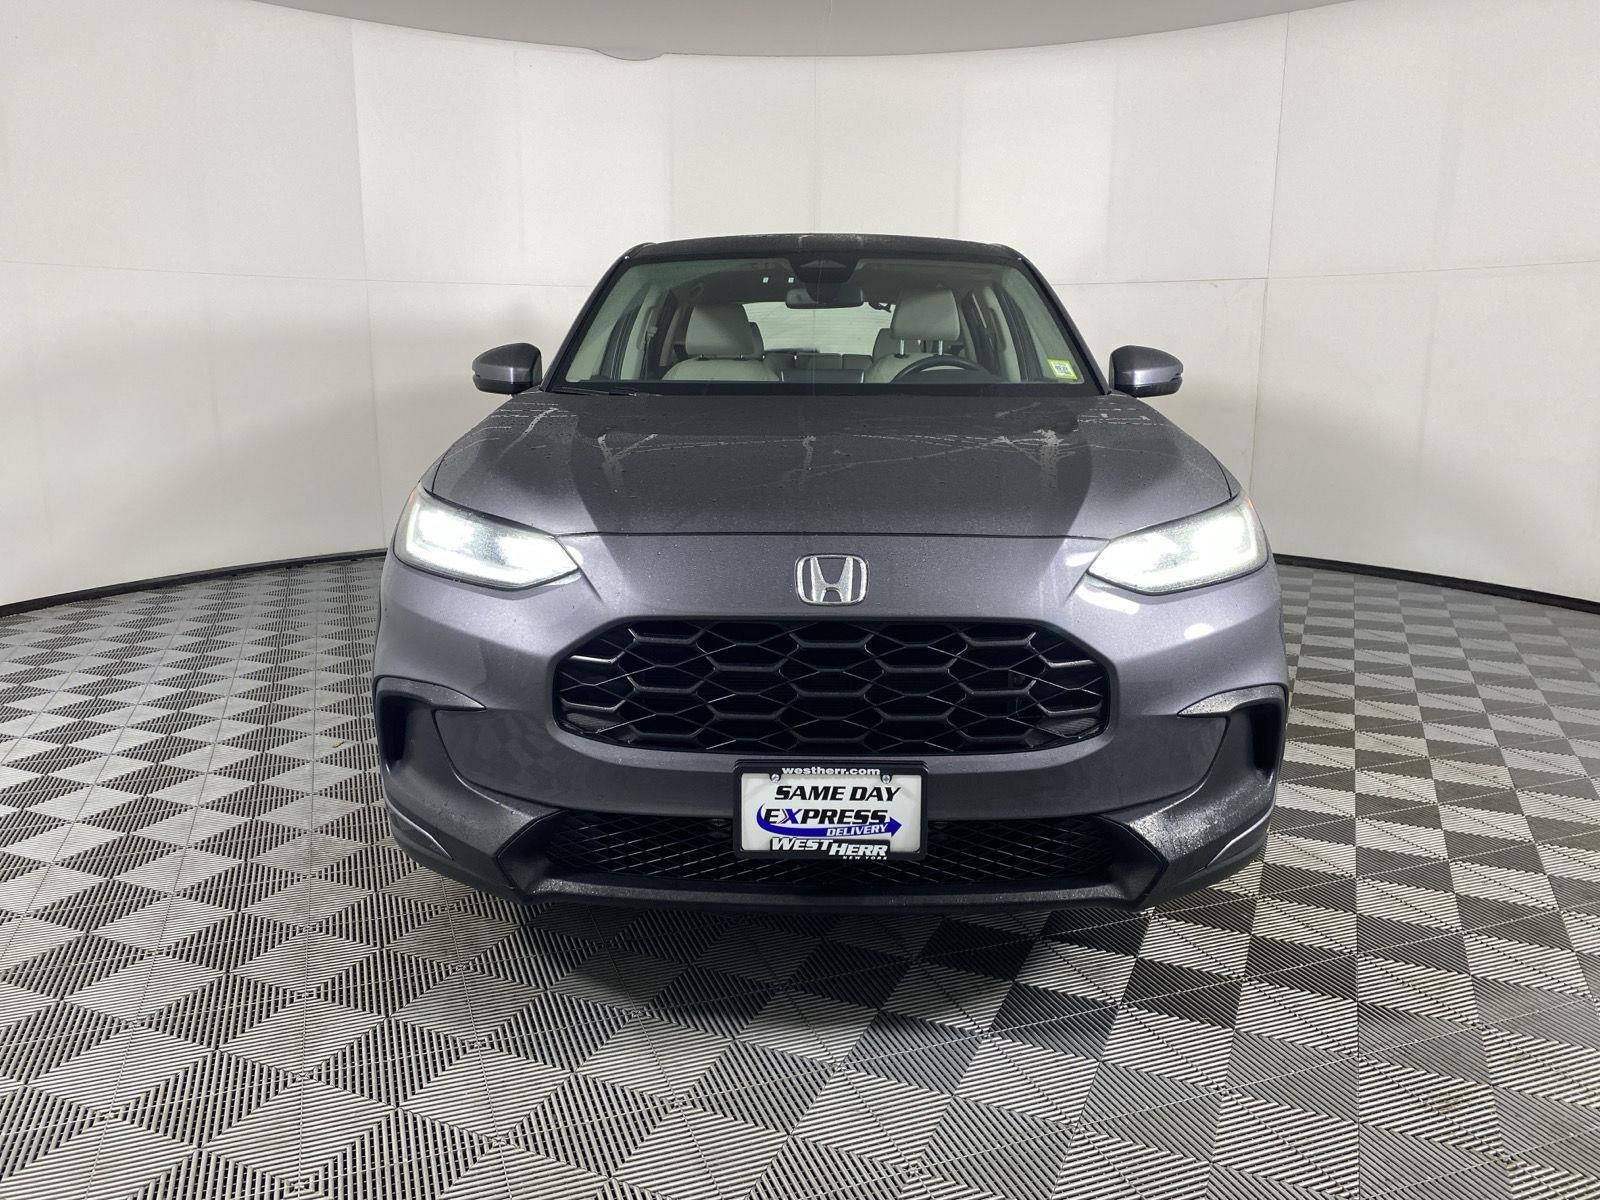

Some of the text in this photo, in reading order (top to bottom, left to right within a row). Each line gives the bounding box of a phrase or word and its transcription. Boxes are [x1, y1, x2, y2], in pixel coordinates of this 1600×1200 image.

[782, 766, 880, 775] westherr.com
[775, 785, 901, 802] SAME DAY
[764, 808, 888, 825] EXPRESS
[826, 824, 888, 836] DELIVERY
